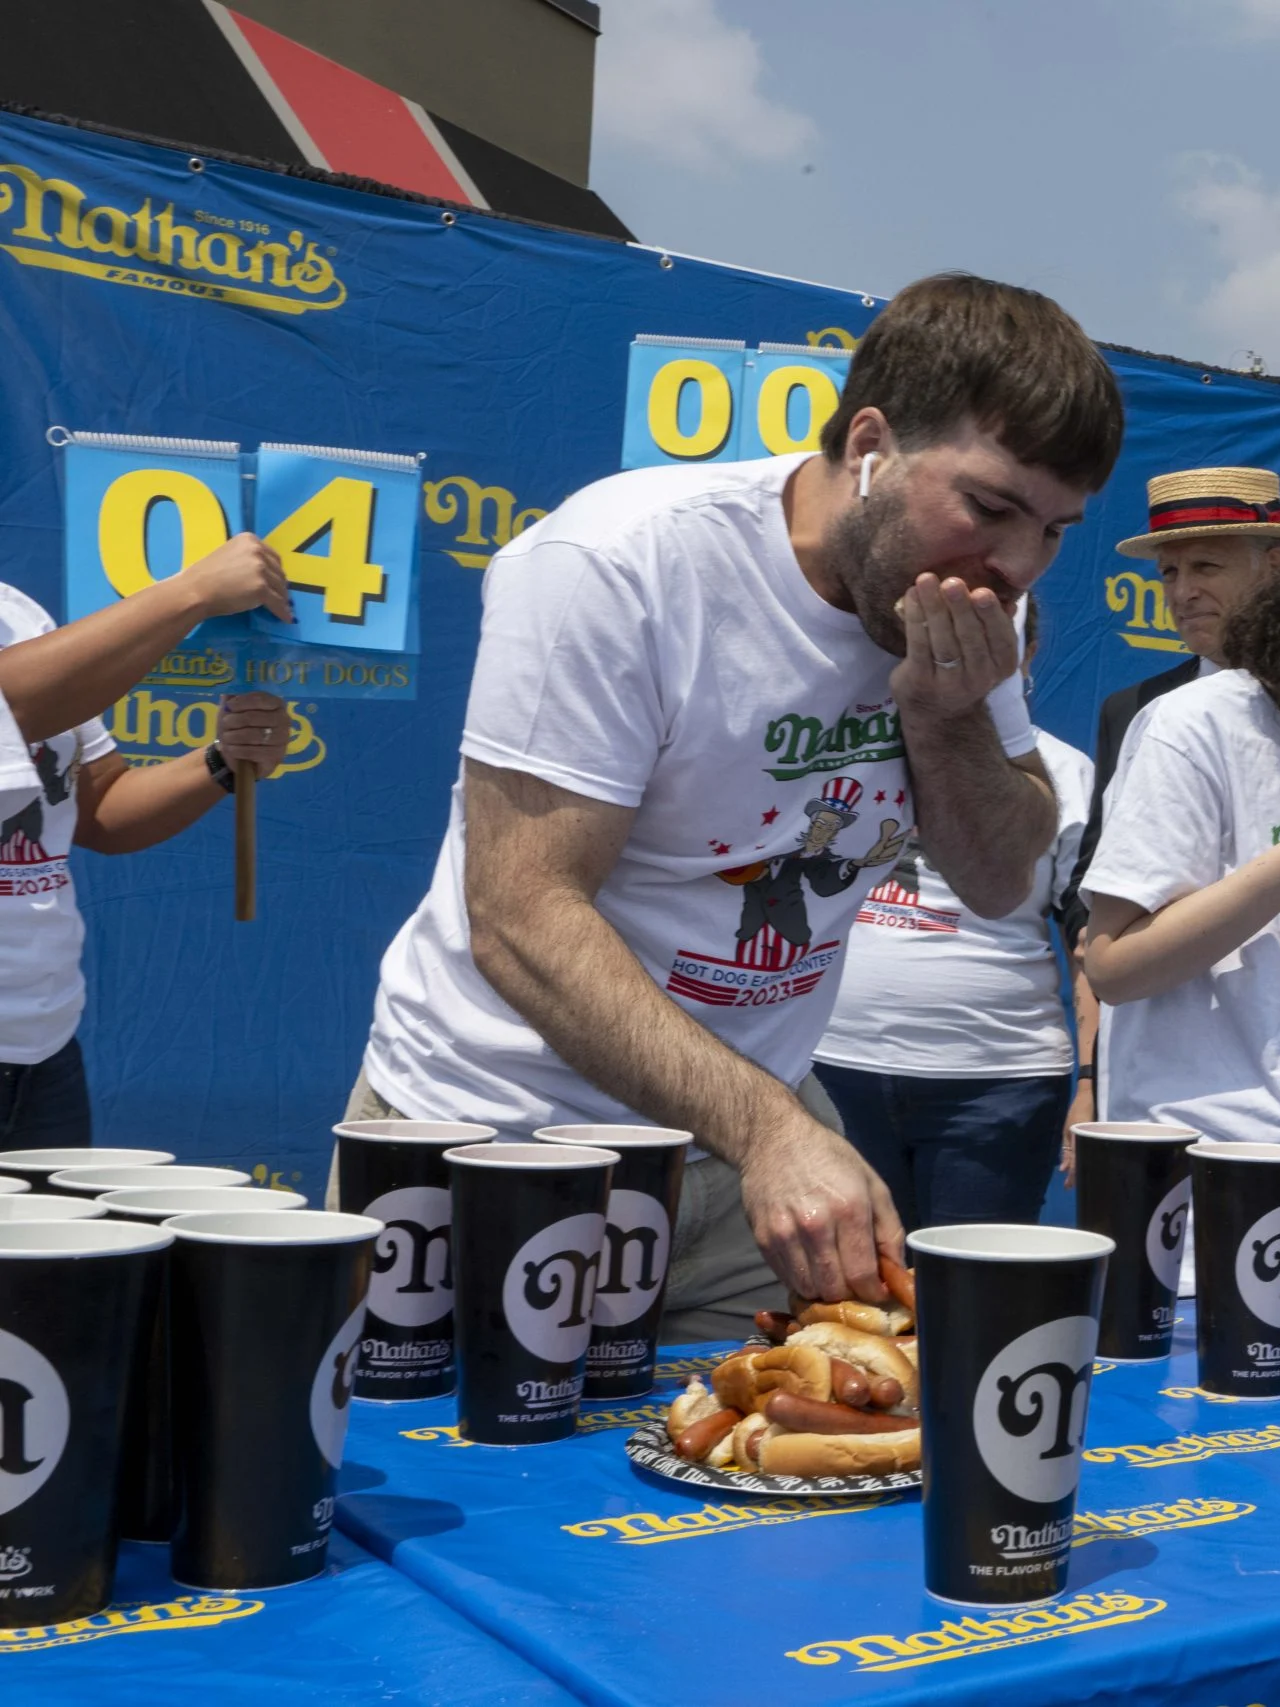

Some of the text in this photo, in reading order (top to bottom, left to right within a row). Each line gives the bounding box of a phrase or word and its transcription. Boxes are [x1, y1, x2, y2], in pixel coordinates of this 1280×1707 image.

[0, 164, 336, 294] Nathan's
[194, 209, 271, 236] Since 1916
[104, 268, 226, 300] FAMOUS
[648, 359, 841, 458] 00
[98, 469, 388, 622] 04
[246, 659, 311, 686] HOT
[324, 662, 409, 688] DOGS
[875, 914, 916, 930] 2023
[672, 959, 709, 978] HOT
[712, 969, 748, 986] DOG
[735, 980, 793, 1007] 2023
[361, 1338, 450, 1359] Nathan's
[587, 1340, 648, 1360] athan's
[365, 1371, 402, 1379] FLAVOR
[403, 1371, 418, 1379] OF
[603, 1368, 637, 1378] OF NEW
[1232, 1370, 1248, 1378] THE
[497, 1414, 518, 1423] THE
[520, 1411, 557, 1422] FLAVOR
[969, 1560, 1057, 1576] THE FLAVOR OF
[784, 1591, 1145, 1665] Nathan's
